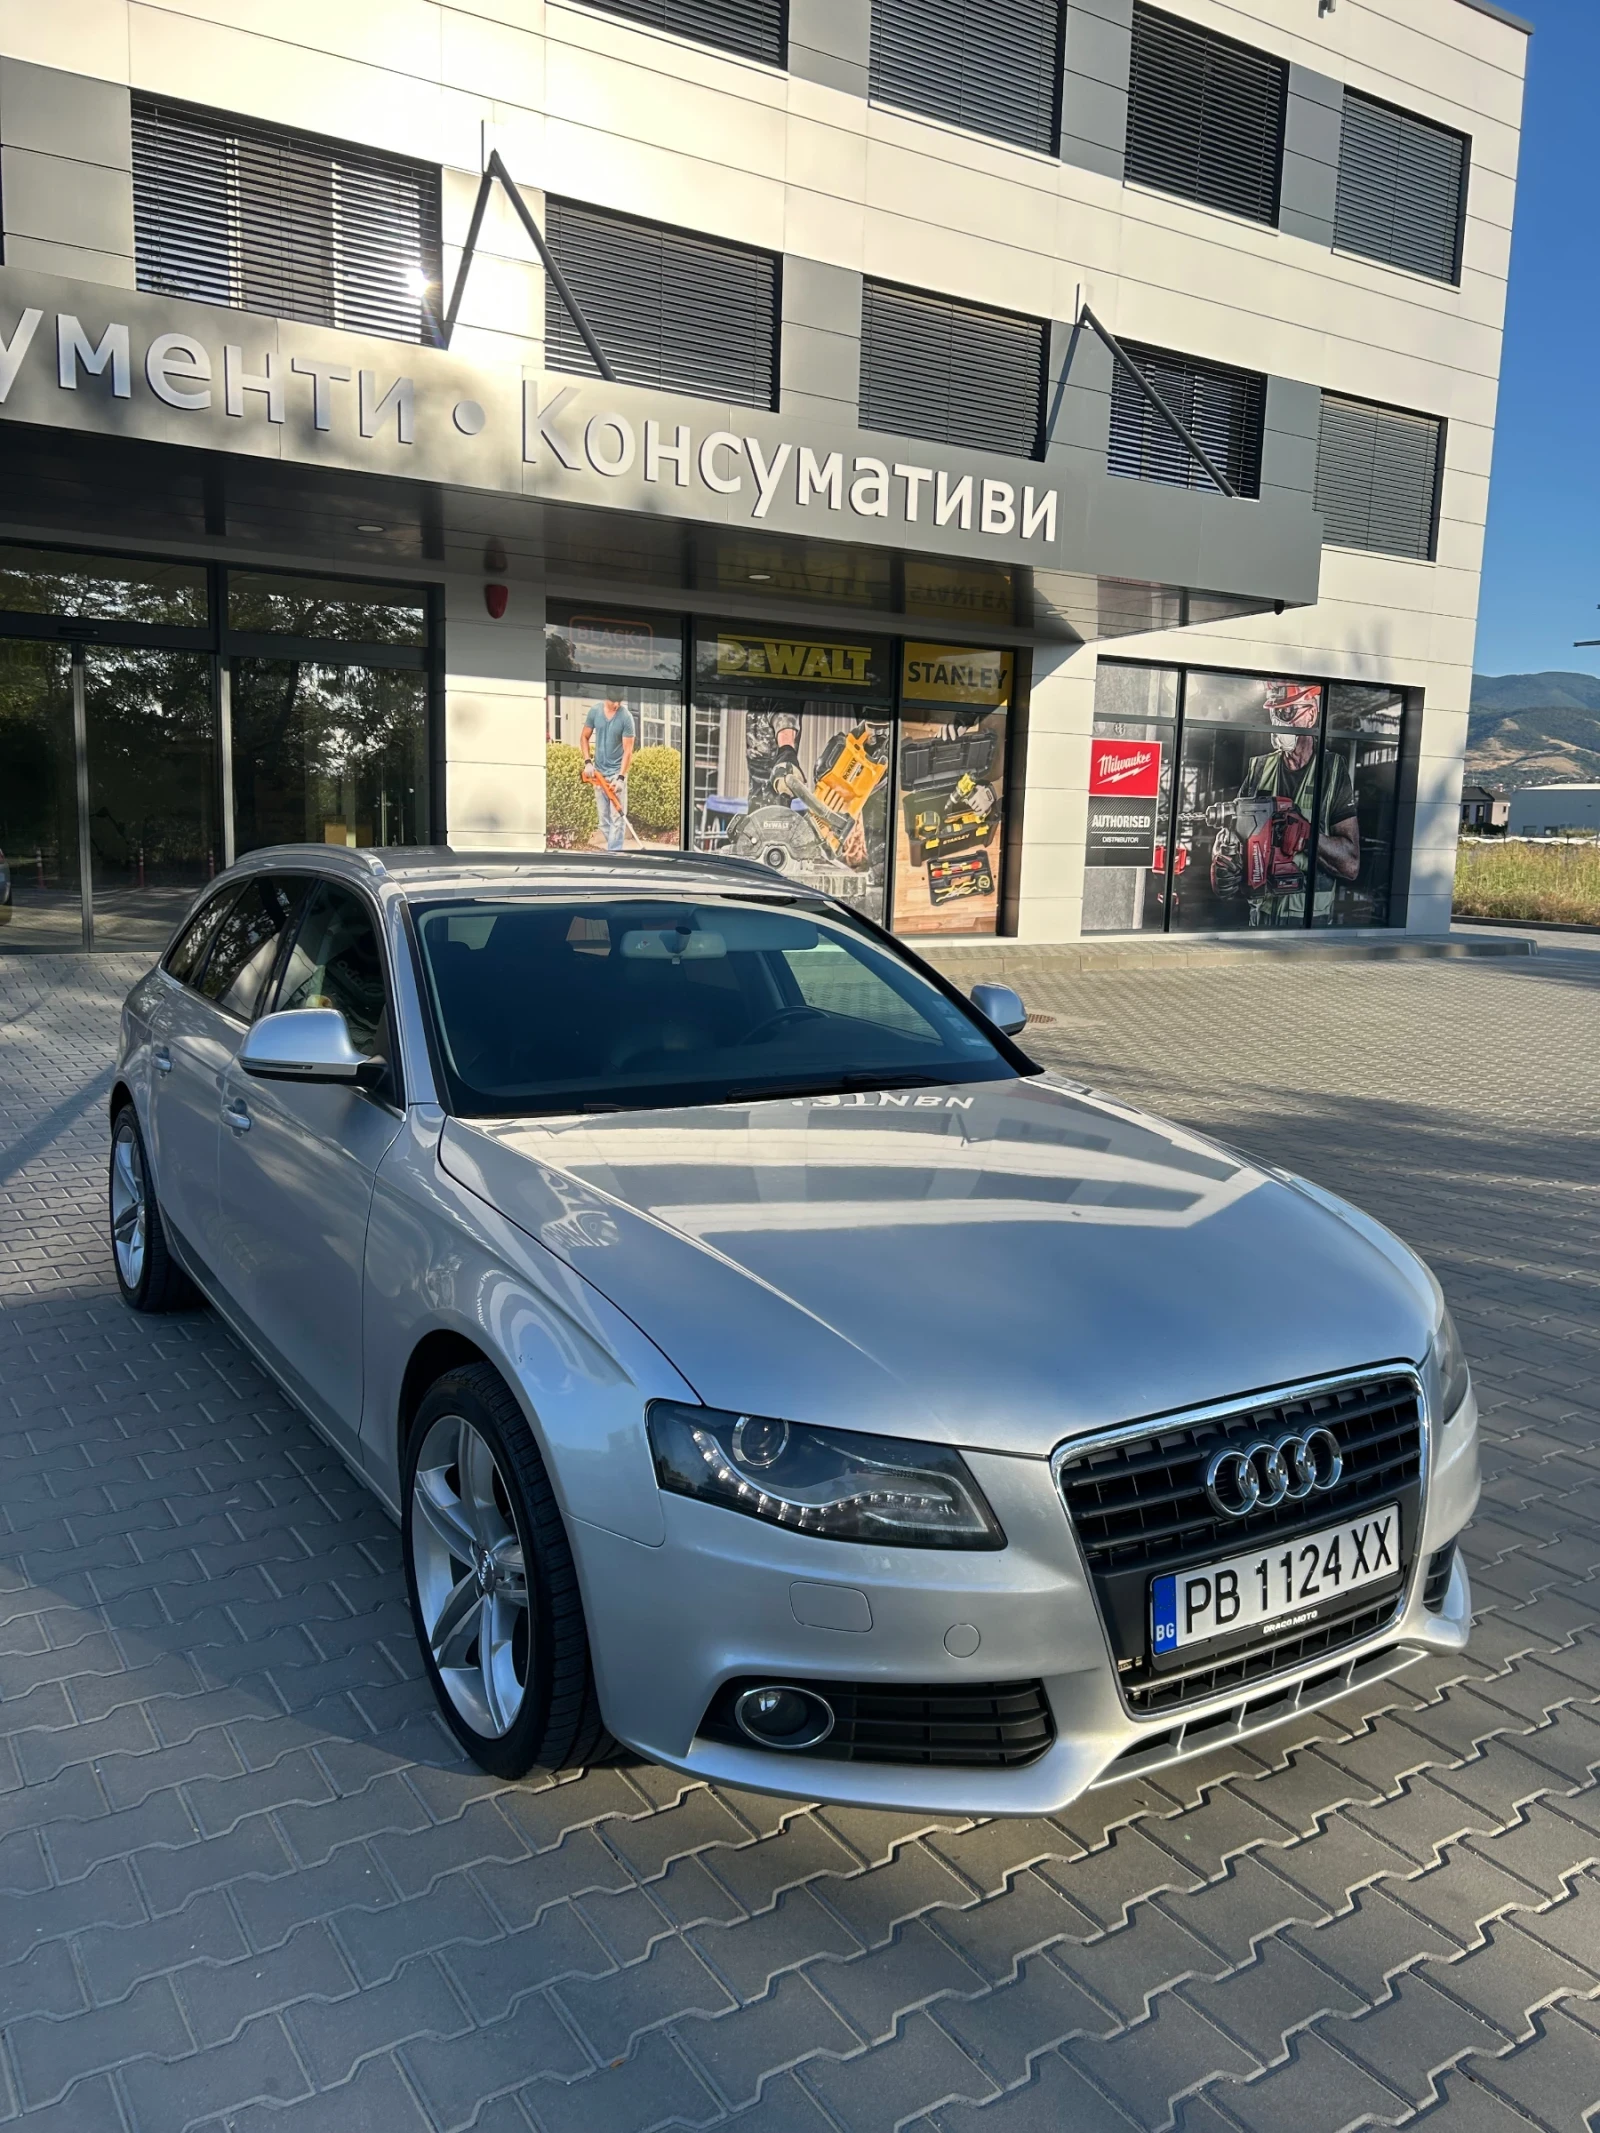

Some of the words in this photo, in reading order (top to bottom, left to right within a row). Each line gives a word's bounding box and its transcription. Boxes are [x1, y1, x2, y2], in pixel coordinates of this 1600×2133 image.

[522, 380, 1059, 543] Консумативи
[908, 661, 1008, 689] STANLEY
[1097, 751, 1152, 777] Milwaukee
[1091, 815, 1150, 828] AUTHORISED
[1185, 1569, 1241, 1634] PB
[1255, 1535, 1342, 1611] 1124
[1351, 1516, 1392, 1580] XX
[1156, 1623, 1175, 1642] BG
[1263, 1619, 1292, 1634] DRACO
[1293, 1610, 1318, 1625] MOTO
